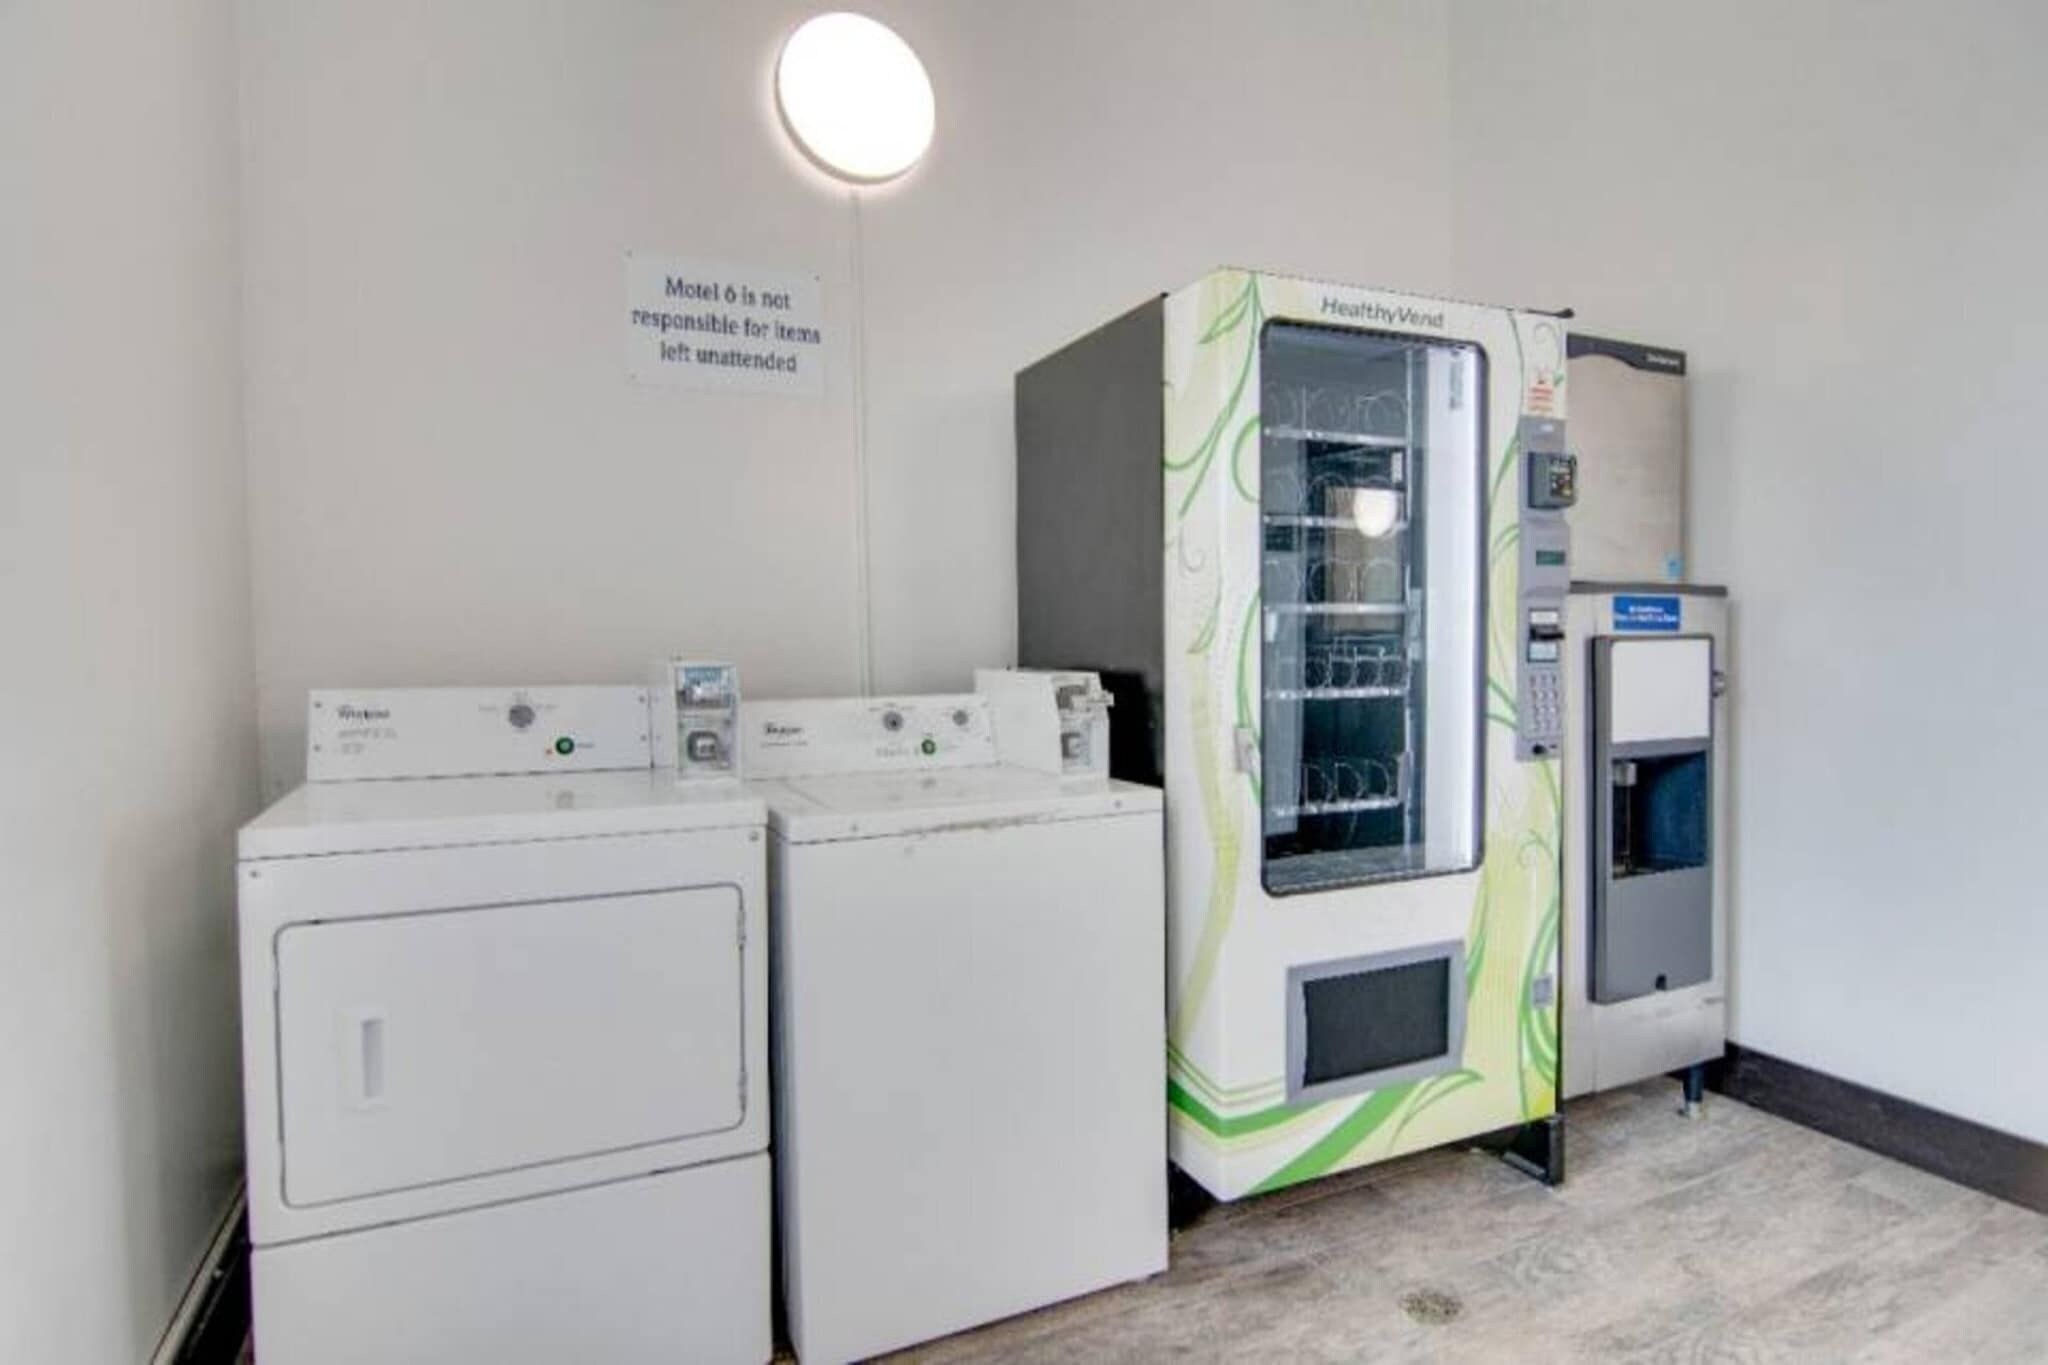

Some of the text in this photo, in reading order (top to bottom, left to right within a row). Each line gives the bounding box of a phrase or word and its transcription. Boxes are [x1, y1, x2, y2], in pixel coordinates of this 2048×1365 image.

[665, 276, 790, 310] Motel 6 is not
[631, 308, 821, 345] responsible for items
[1321, 295, 1444, 327] HealthyVend
[660, 341, 797, 373] left unattended
